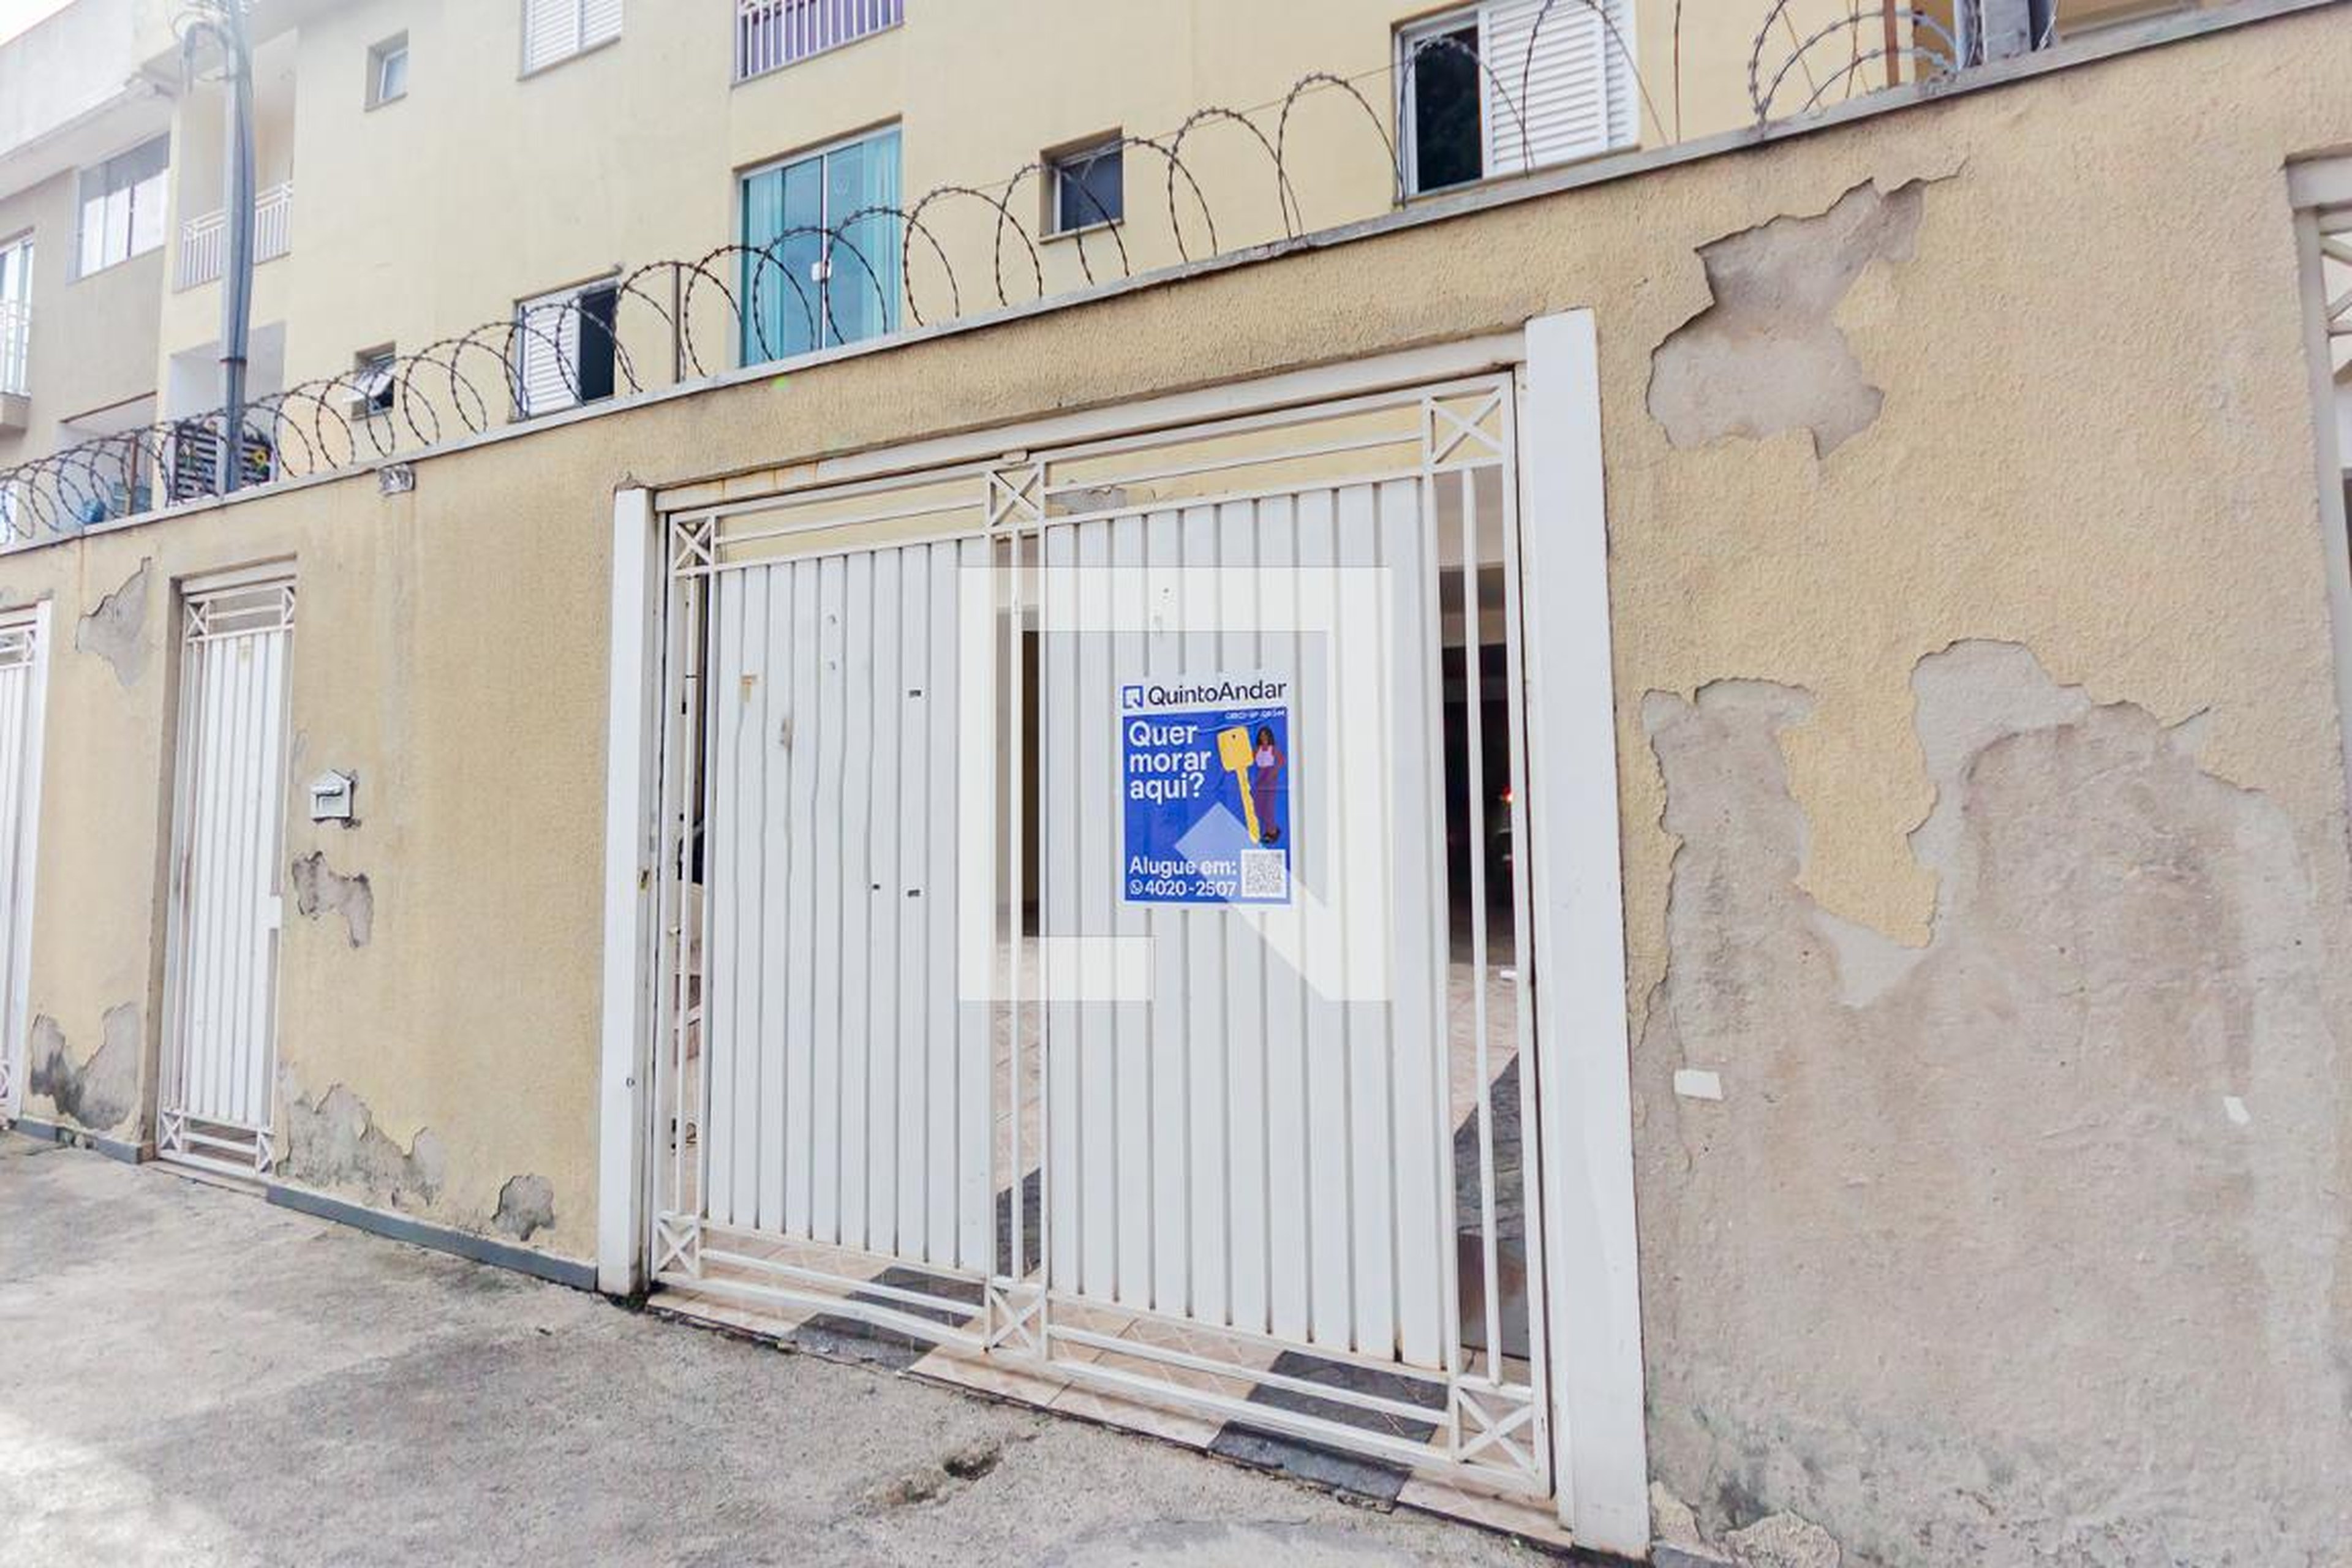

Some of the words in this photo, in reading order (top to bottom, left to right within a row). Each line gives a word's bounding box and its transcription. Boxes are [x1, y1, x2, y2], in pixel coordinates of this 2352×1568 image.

[1148, 679, 1287, 706] QuintoAndar
[1129, 721, 1199, 747] Quer
[1130, 750, 1212, 773] morar
[1131, 774, 1205, 805] aqui?
[1129, 855, 1196, 879] Alugue
[1200, 860, 1237, 875] em:
